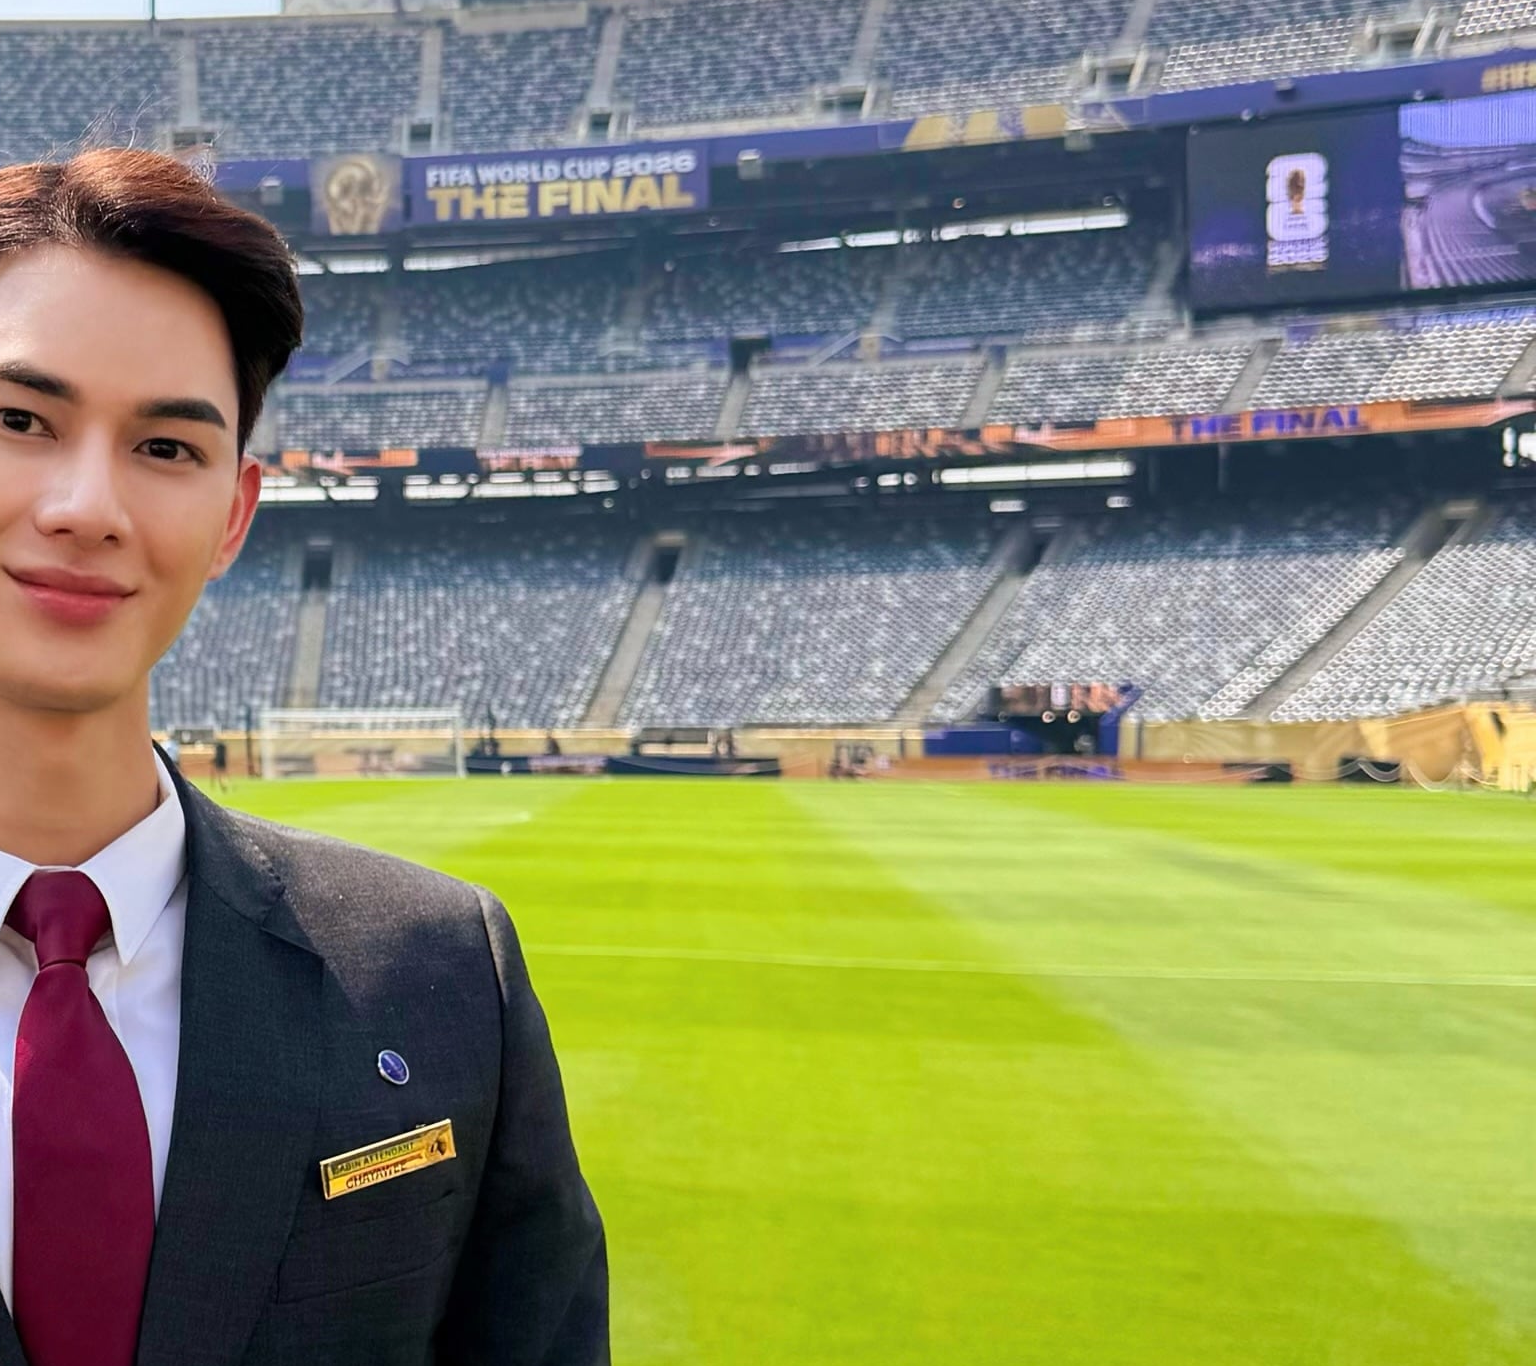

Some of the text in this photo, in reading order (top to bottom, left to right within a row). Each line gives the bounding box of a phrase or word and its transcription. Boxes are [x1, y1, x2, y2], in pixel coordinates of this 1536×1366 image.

[426, 150, 697, 188] FIFA WORLD CUP 2026
[426, 174, 695, 222] THE FINAL
[1168, 407, 1369, 440] THE FINAL
[364, 1141, 415, 1165] ATTENDANT
